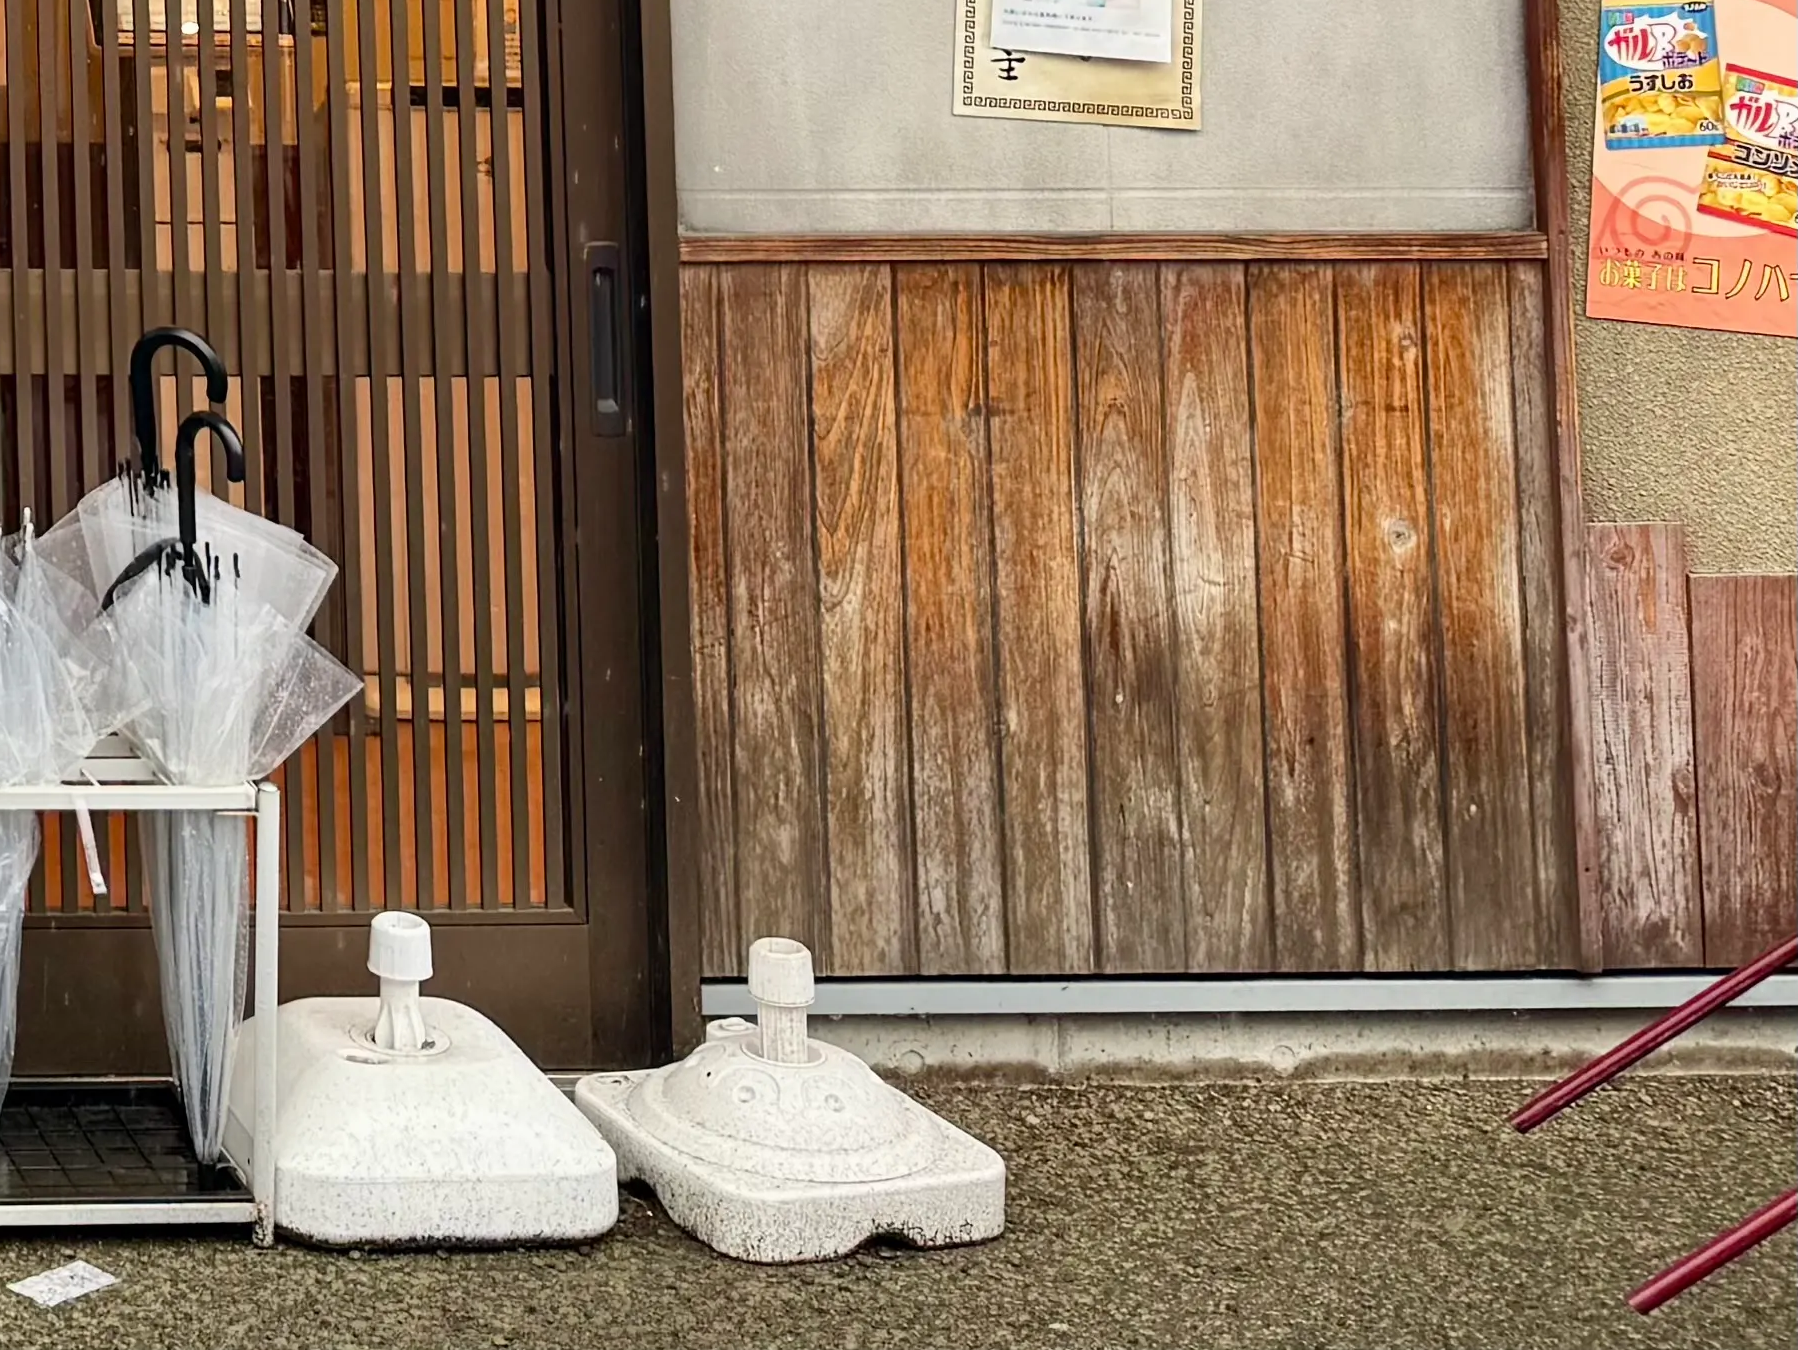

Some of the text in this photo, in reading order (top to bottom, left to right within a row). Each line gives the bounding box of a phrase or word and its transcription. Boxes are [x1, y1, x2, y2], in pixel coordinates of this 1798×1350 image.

[1629, 73, 1694, 93] うすしお
[1691, 256, 1798, 302] コノハ
